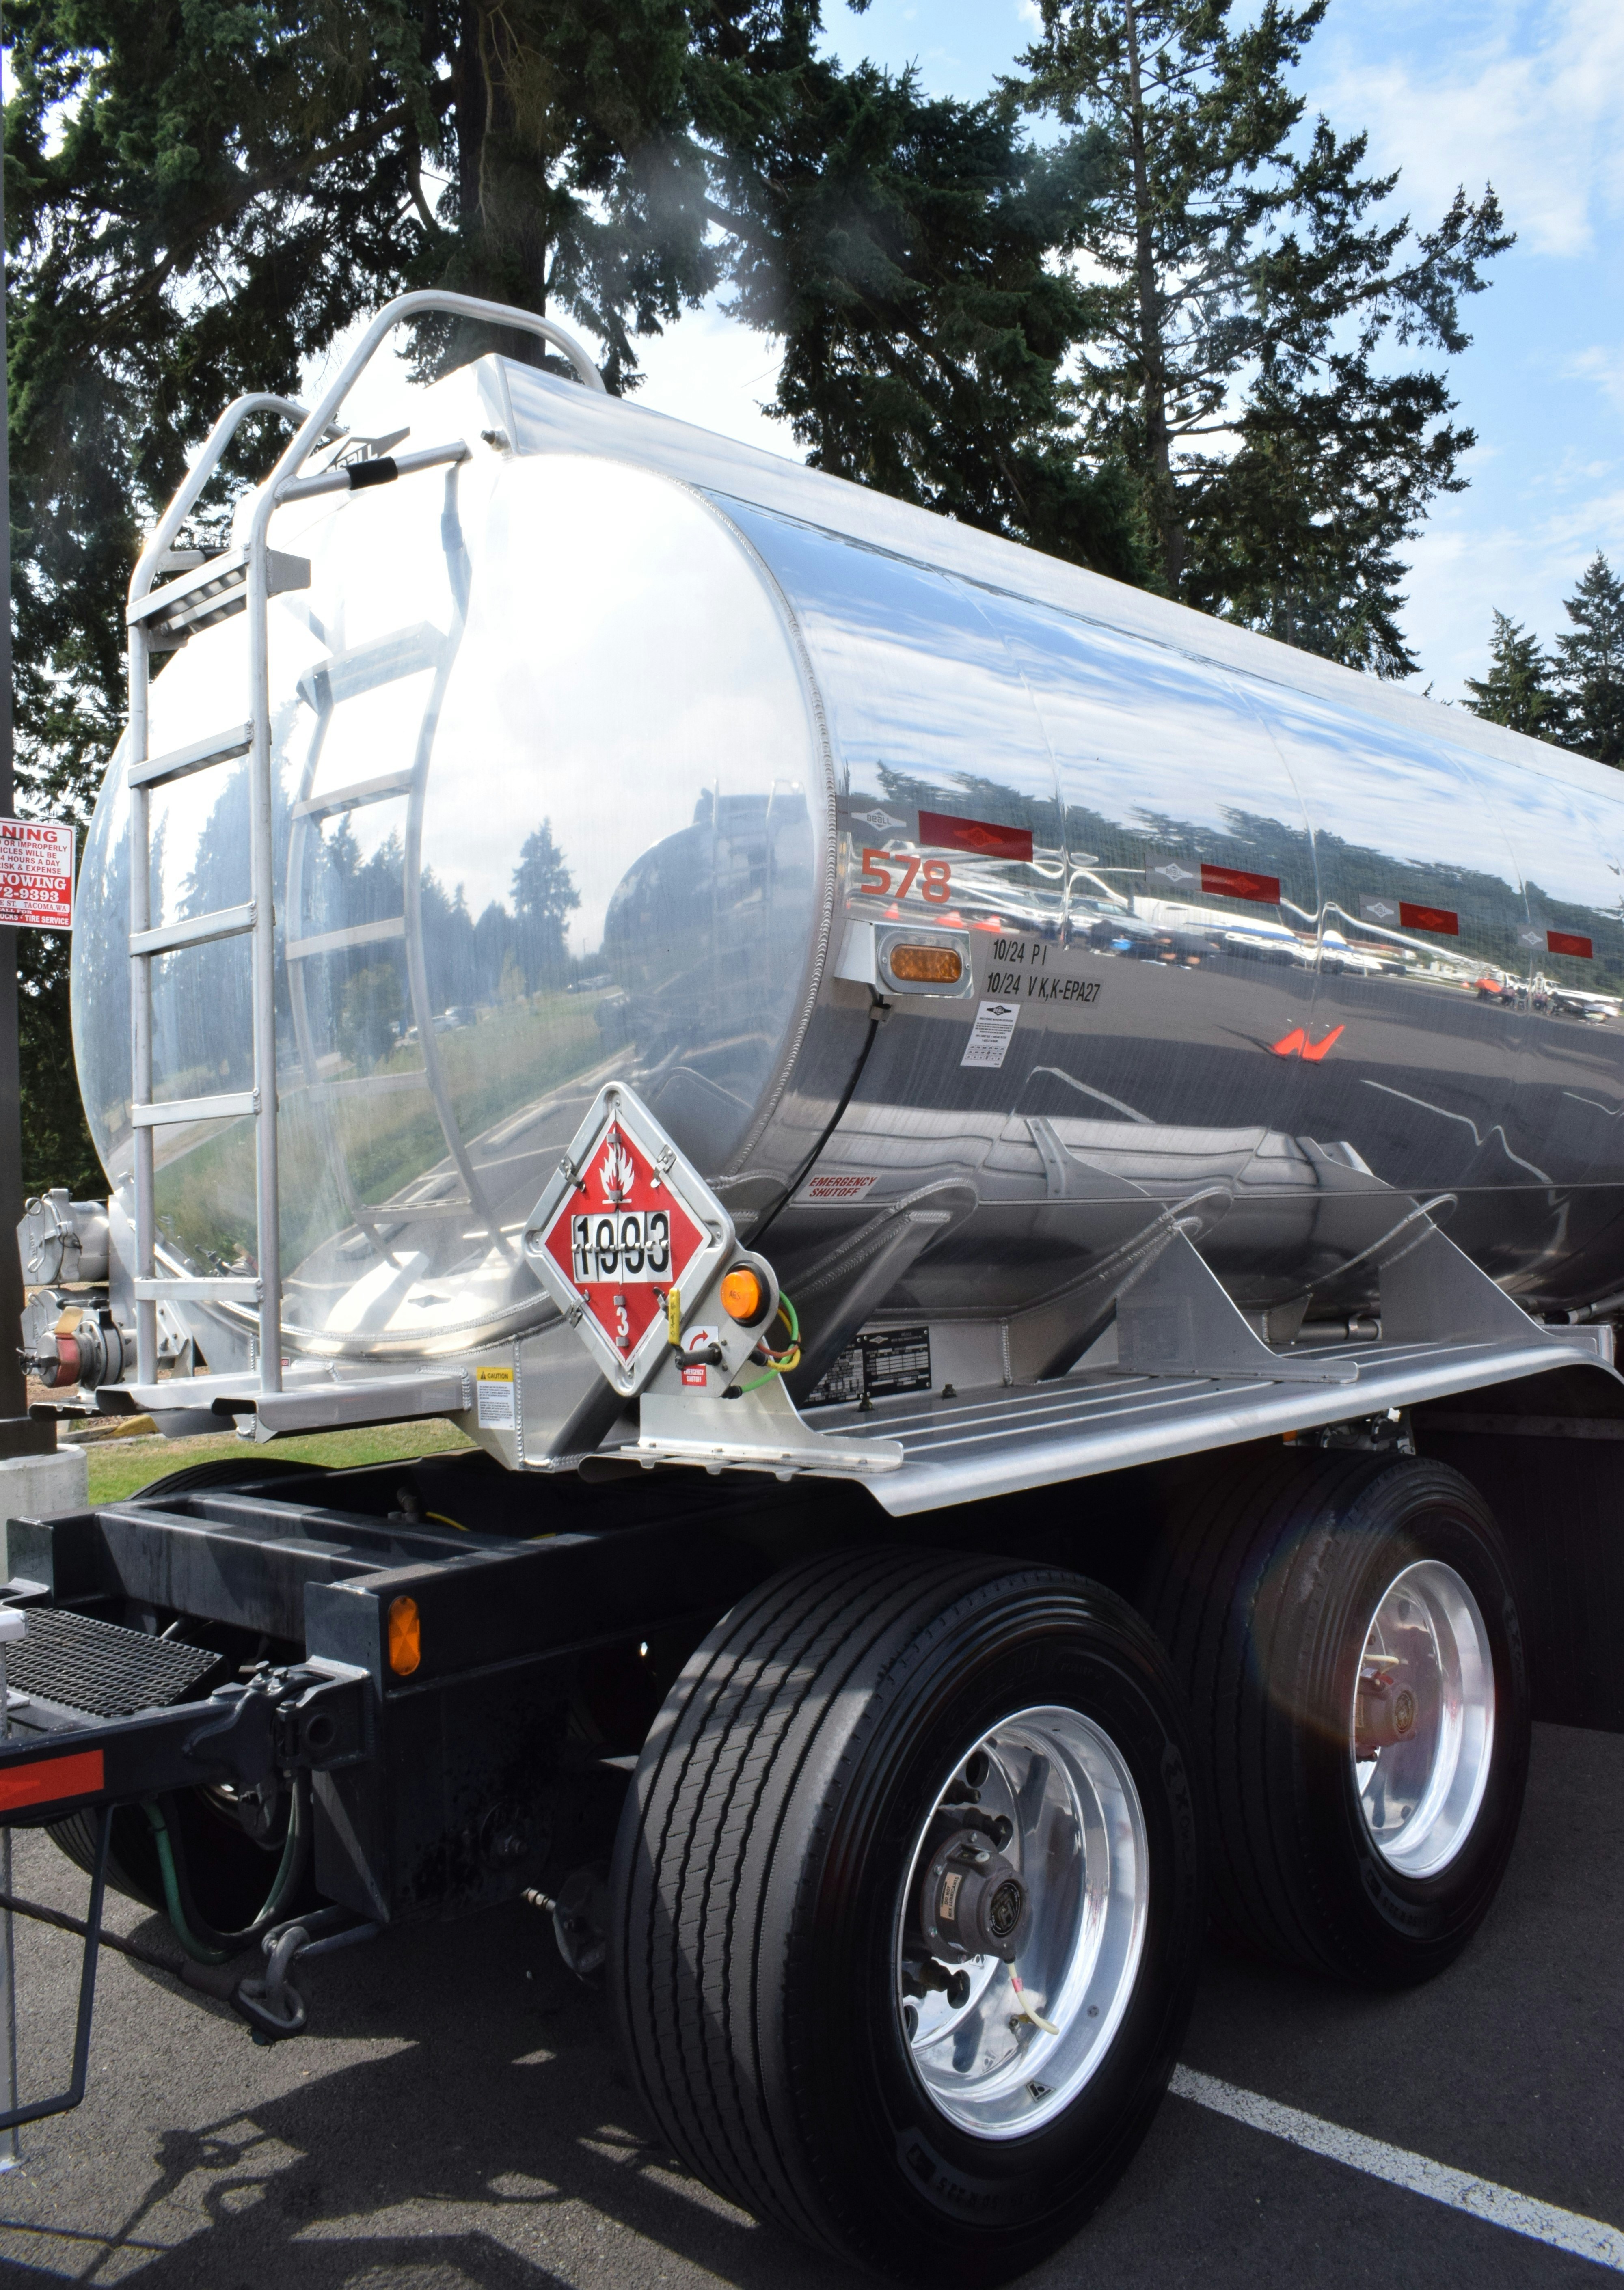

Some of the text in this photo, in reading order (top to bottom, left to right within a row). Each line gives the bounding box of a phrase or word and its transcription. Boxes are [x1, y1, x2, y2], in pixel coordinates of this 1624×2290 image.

[18, 841, 67, 852] IMPROPERLY
[8, 855, 35, 864] HOURS
[26, 865, 61, 874] EXPENSE
[861, 848, 951, 903] 578
[41, 916, 69, 925] SERVICE
[994, 939, 1025, 963] 10/24
[987, 972, 1021, 995] 10/24
[1038, 977, 1101, 1002] K,K-EPA27
[809, 1177, 877, 1187] EMERGENCY
[809, 1188, 861, 1197] SHUTOFF
[577, 1213, 669, 1275] 1993
[729, 1290, 741, 1300] ABS
[616, 1306, 629, 1337] 3
[949, 1876, 959, 1906] LUBRICANTS
[944, 1897, 949, 1905] DO
